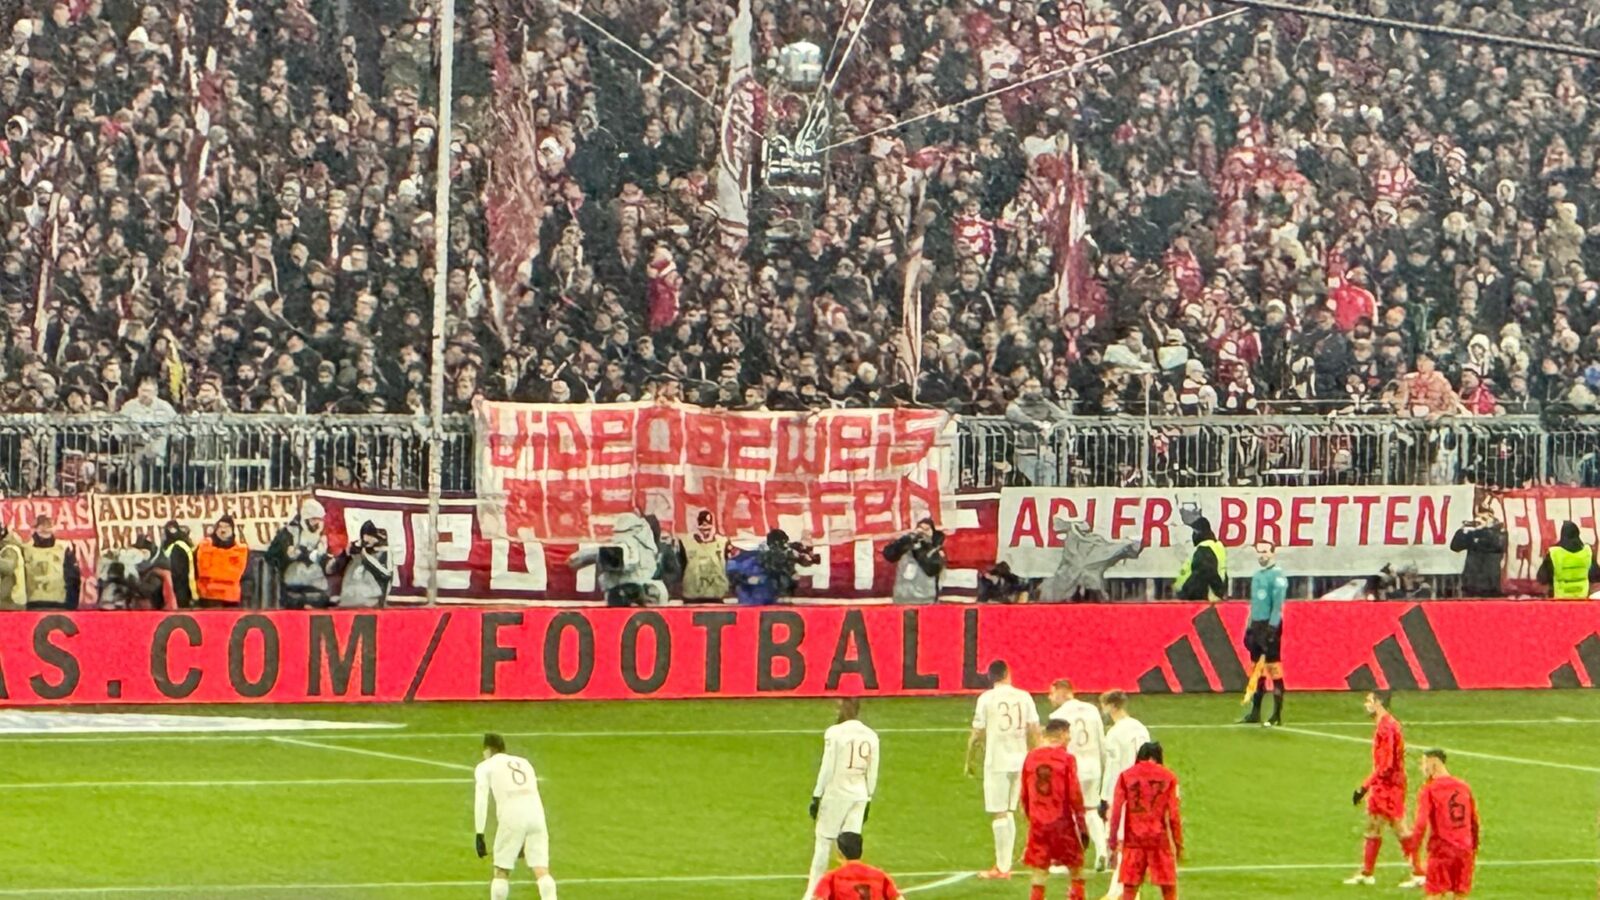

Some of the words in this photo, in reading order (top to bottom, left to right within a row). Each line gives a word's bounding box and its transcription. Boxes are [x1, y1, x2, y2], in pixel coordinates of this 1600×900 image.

[1218, 494, 1451, 547] BRETTEN
[998, 701, 1023, 732] 31
[847, 739, 873, 769] 19
[507, 760, 527, 786] 8
[1128, 778, 1167, 814] 17
[1448, 789, 1466, 823] 6
